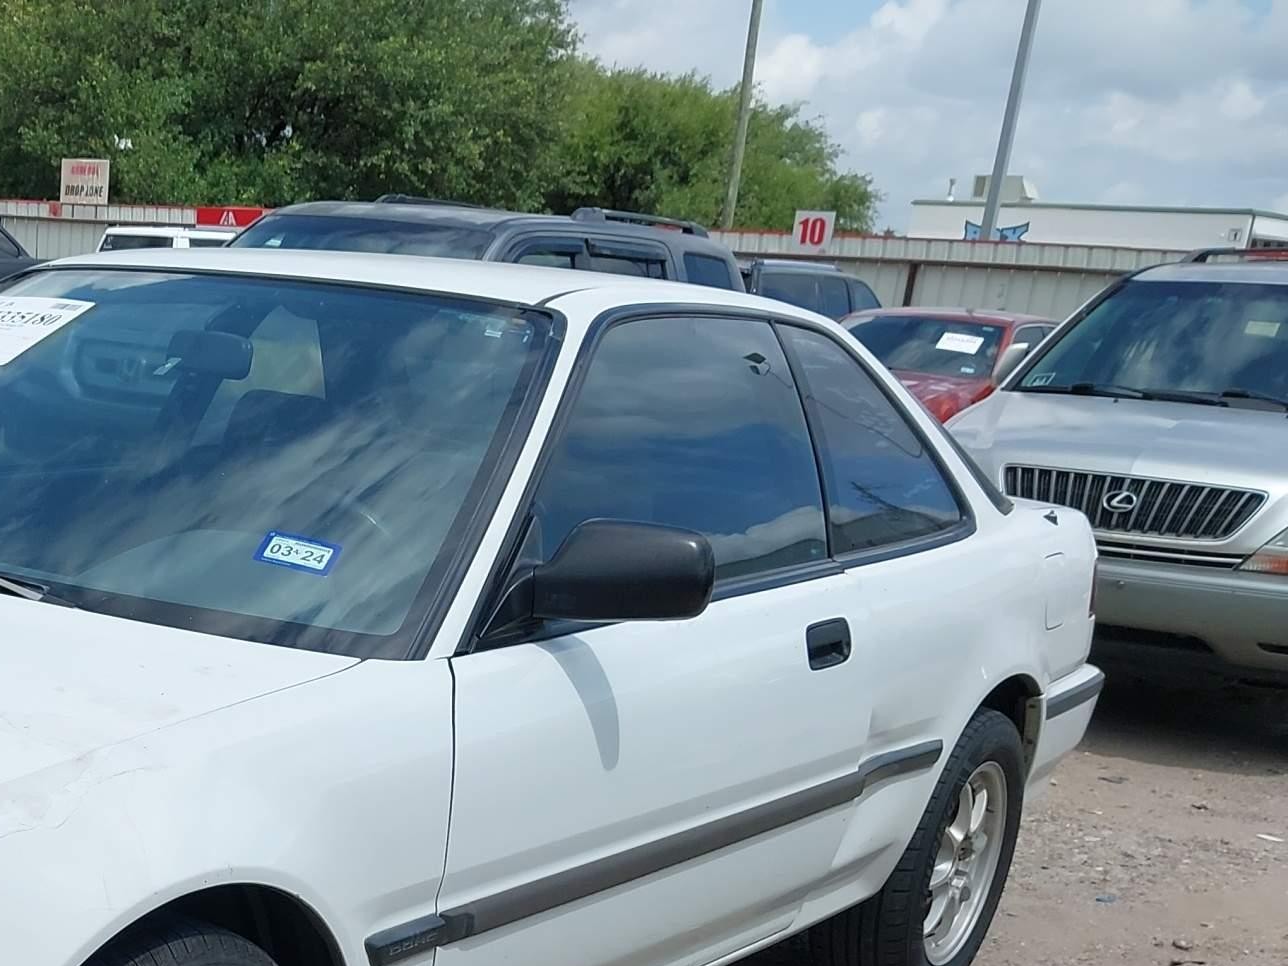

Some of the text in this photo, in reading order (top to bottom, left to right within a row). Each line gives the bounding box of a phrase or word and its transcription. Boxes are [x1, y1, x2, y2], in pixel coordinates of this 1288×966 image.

[799, 217, 826, 245] 10
[269, 543, 294, 557] 03
[300, 550, 326, 565] 24
